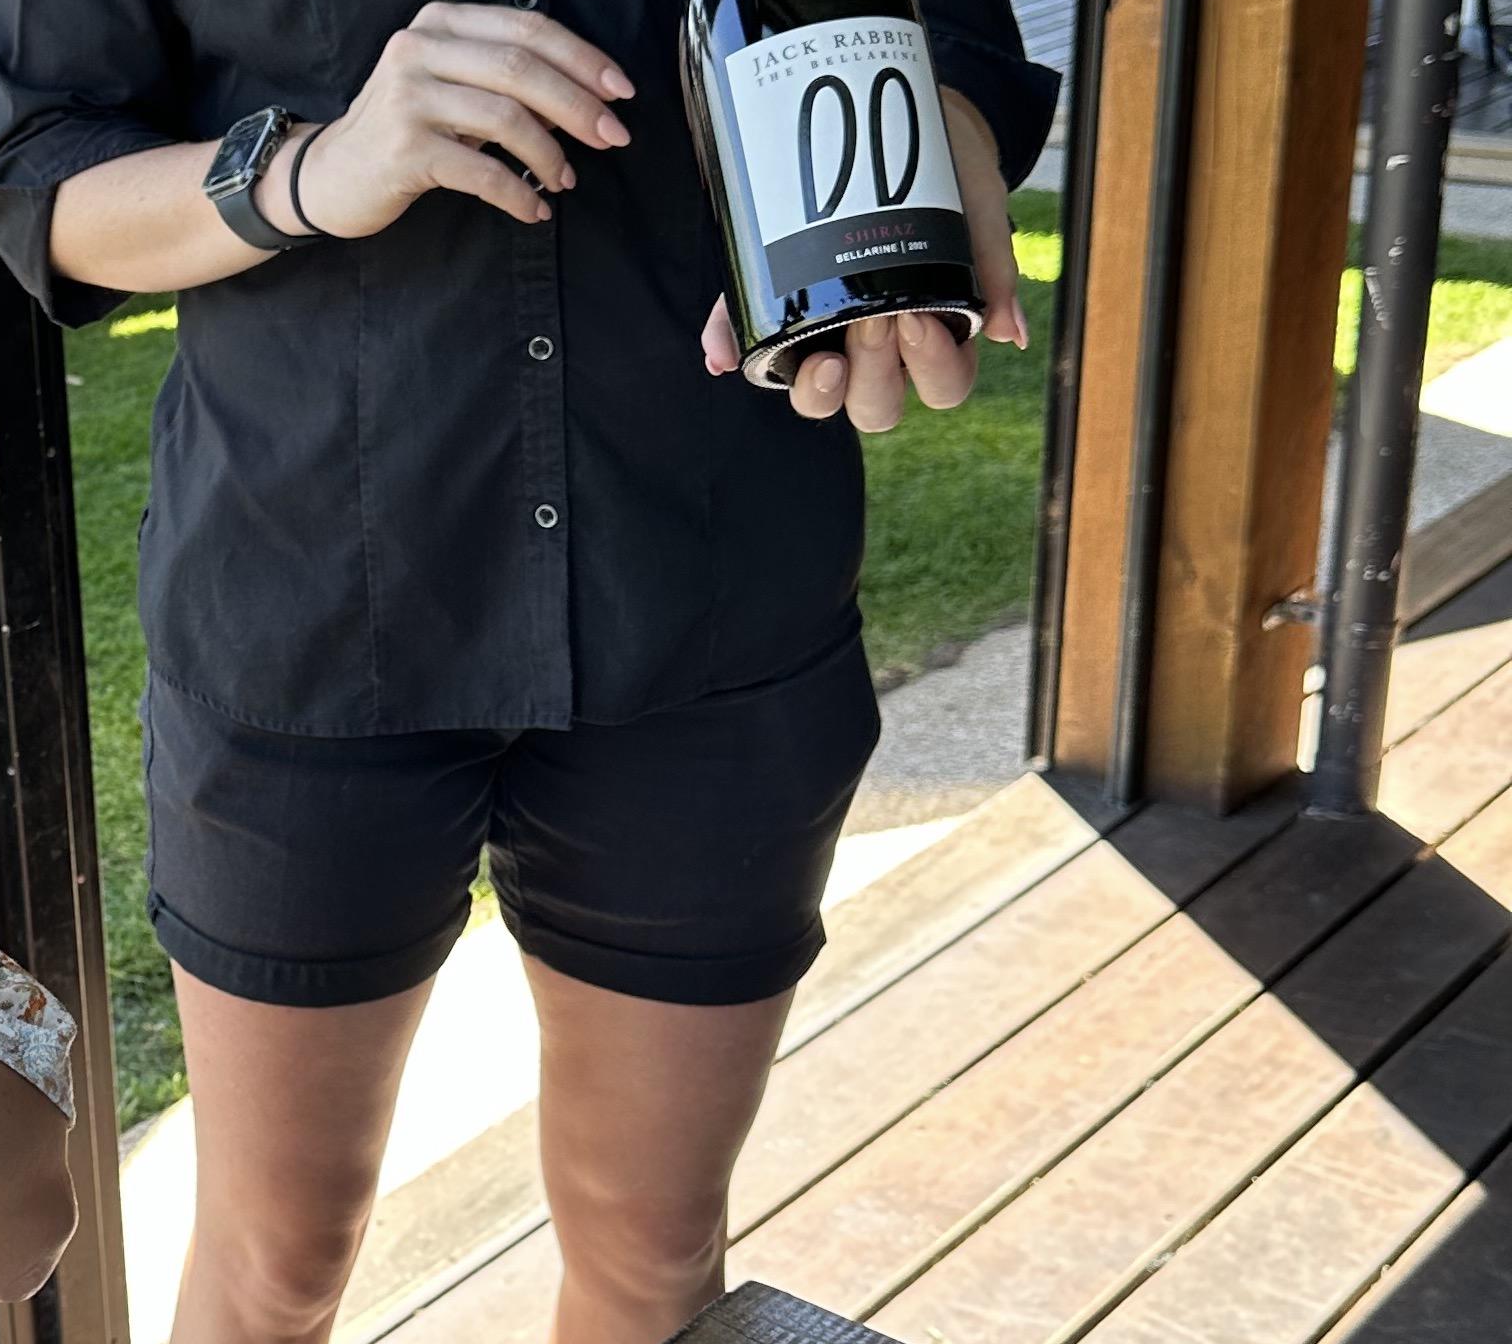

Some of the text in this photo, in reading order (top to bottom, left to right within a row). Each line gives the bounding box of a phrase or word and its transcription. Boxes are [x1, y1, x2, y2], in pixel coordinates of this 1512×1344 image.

[753, 30, 914, 76] JACK RABBIT
[757, 52, 920, 88] THE BELLARINE
[843, 223, 915, 245] SHIRAZ
[835, 240, 928, 264] BELLARINE 2021
